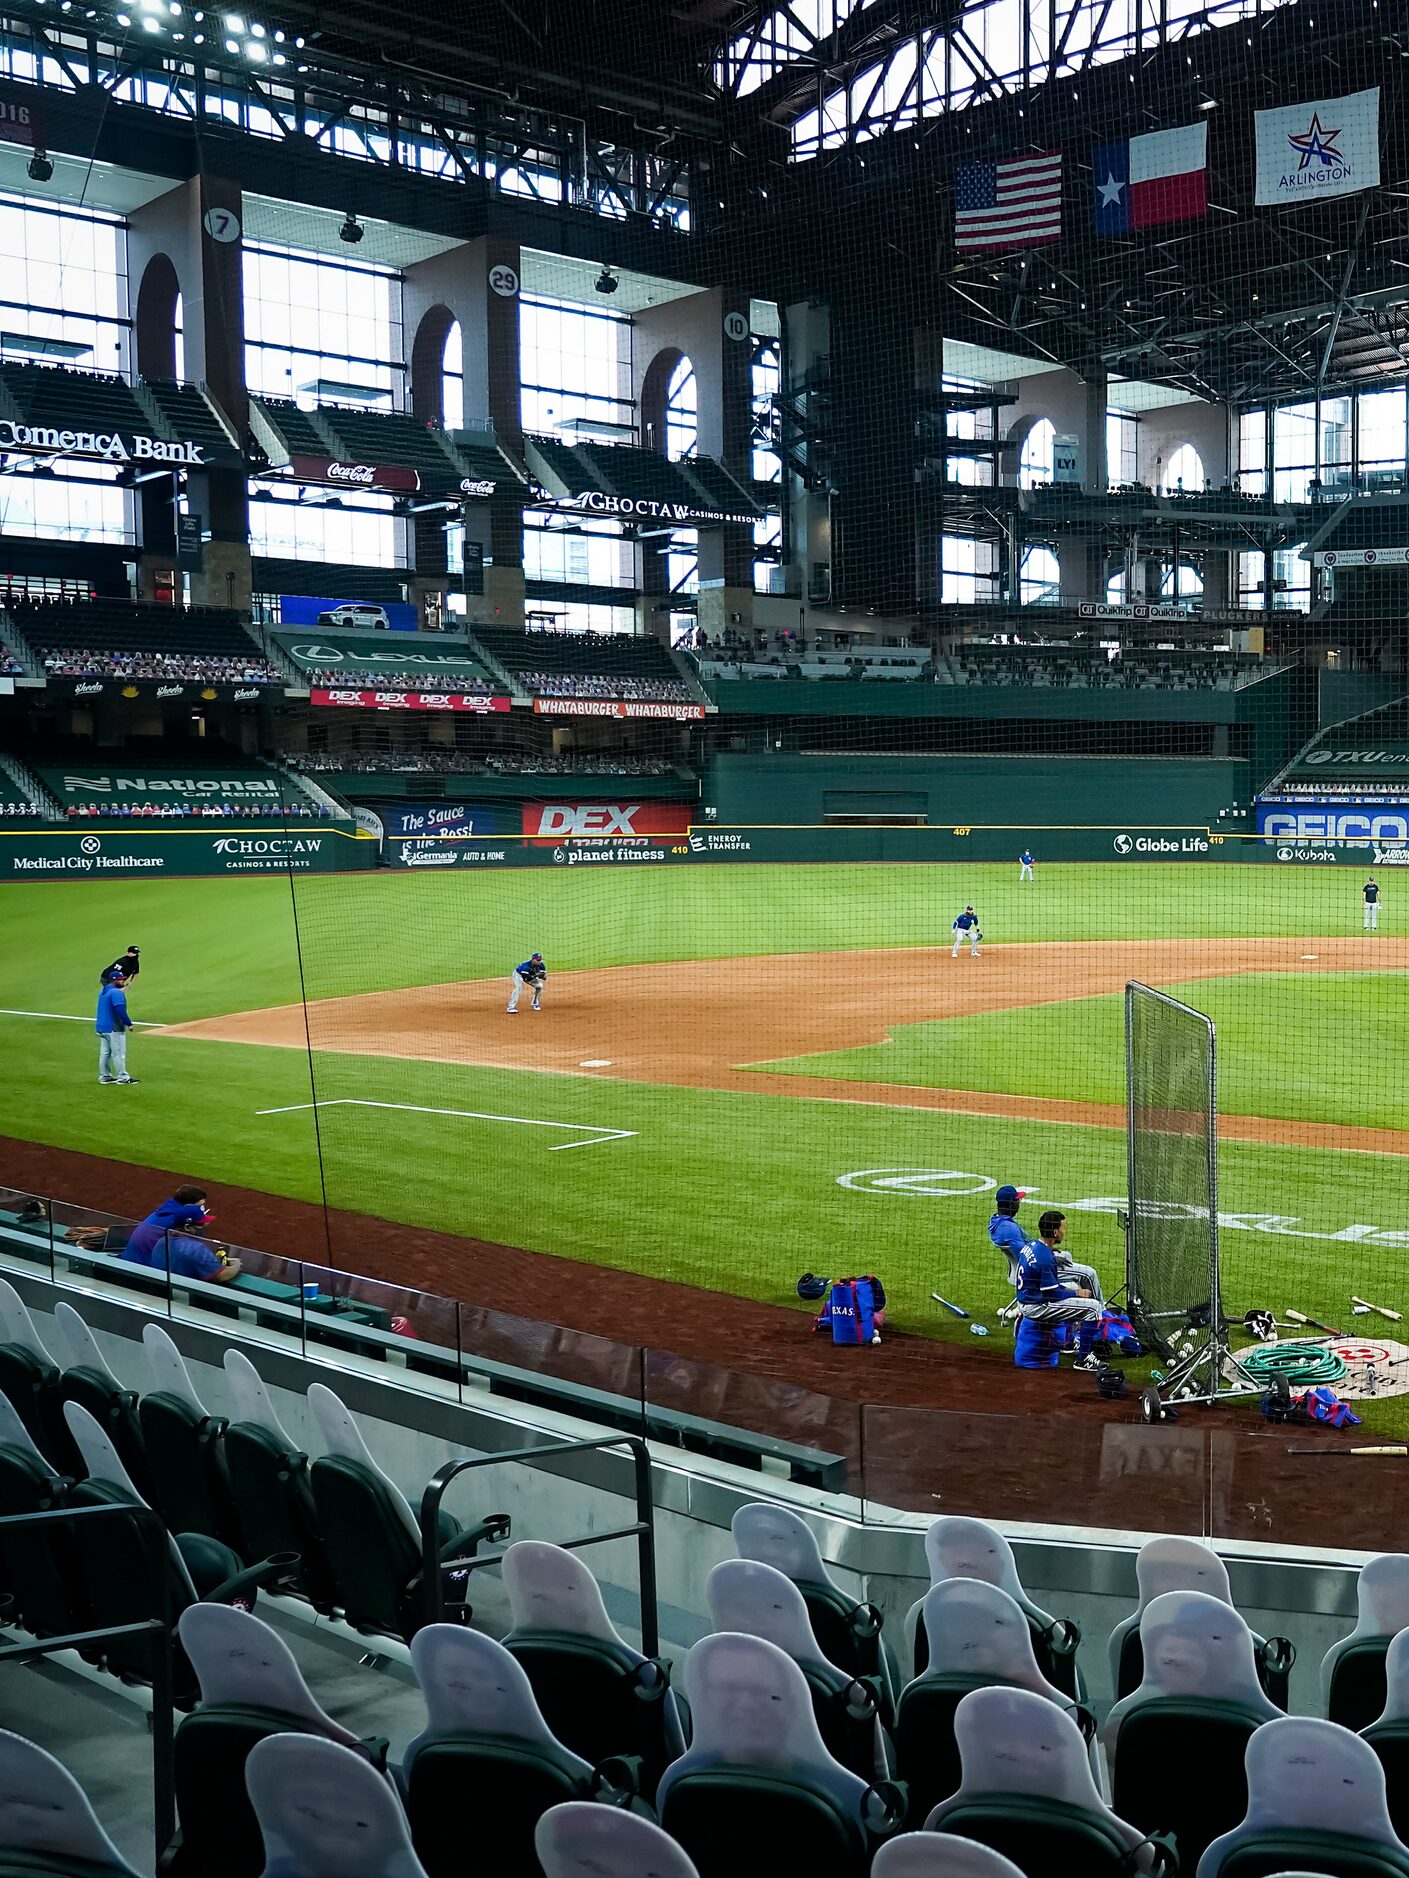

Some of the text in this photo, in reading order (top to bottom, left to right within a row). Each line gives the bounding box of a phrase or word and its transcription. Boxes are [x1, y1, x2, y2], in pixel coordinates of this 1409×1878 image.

[1279, 165, 1352, 188] ARLINGTON
[214, 215, 229, 235] 7
[493, 271, 515, 290] 29
[729, 318, 743, 334] 10
[133, 436, 205, 464] Bank
[589, 492, 689, 520] CHOCTAW
[690, 510, 724, 520] CASINOS
[1098, 604, 1132, 617] QuikTrip
[1151, 606, 1185, 619] QuikTrip
[1203, 611, 1269, 621] PLUCKERS
[347, 651, 473, 665] LEXUS
[328, 690, 363, 701] DEX
[374, 692, 408, 703] DEX
[419, 694, 451, 705] DEX
[462, 696, 493, 706] DEX
[539, 701, 702, 718] WHATABURGER WHATABURGER
[401, 806, 465, 832] The Sauce
[538, 805, 640, 835] DEX
[953, 828, 971, 836] 407
[1264, 814, 1407, 848] GEICO
[224, 838, 322, 853] CHOCTAW
[708, 835, 742, 843] ENERGY
[708, 842, 751, 850] TRANSFER
[1135, 837, 1209, 852] Globe Life
[1209, 836, 1224, 844] 410
[416, 851, 457, 860] Germania
[463, 852, 505, 861] AUTO & HOME
[568, 848, 665, 864] planet fitness
[672, 846, 688, 855] 410
[1295, 848, 1336, 861] Kubota
[13, 855, 164, 870] Medical City Healthcare
[274, 860, 310, 868] RESORTS
